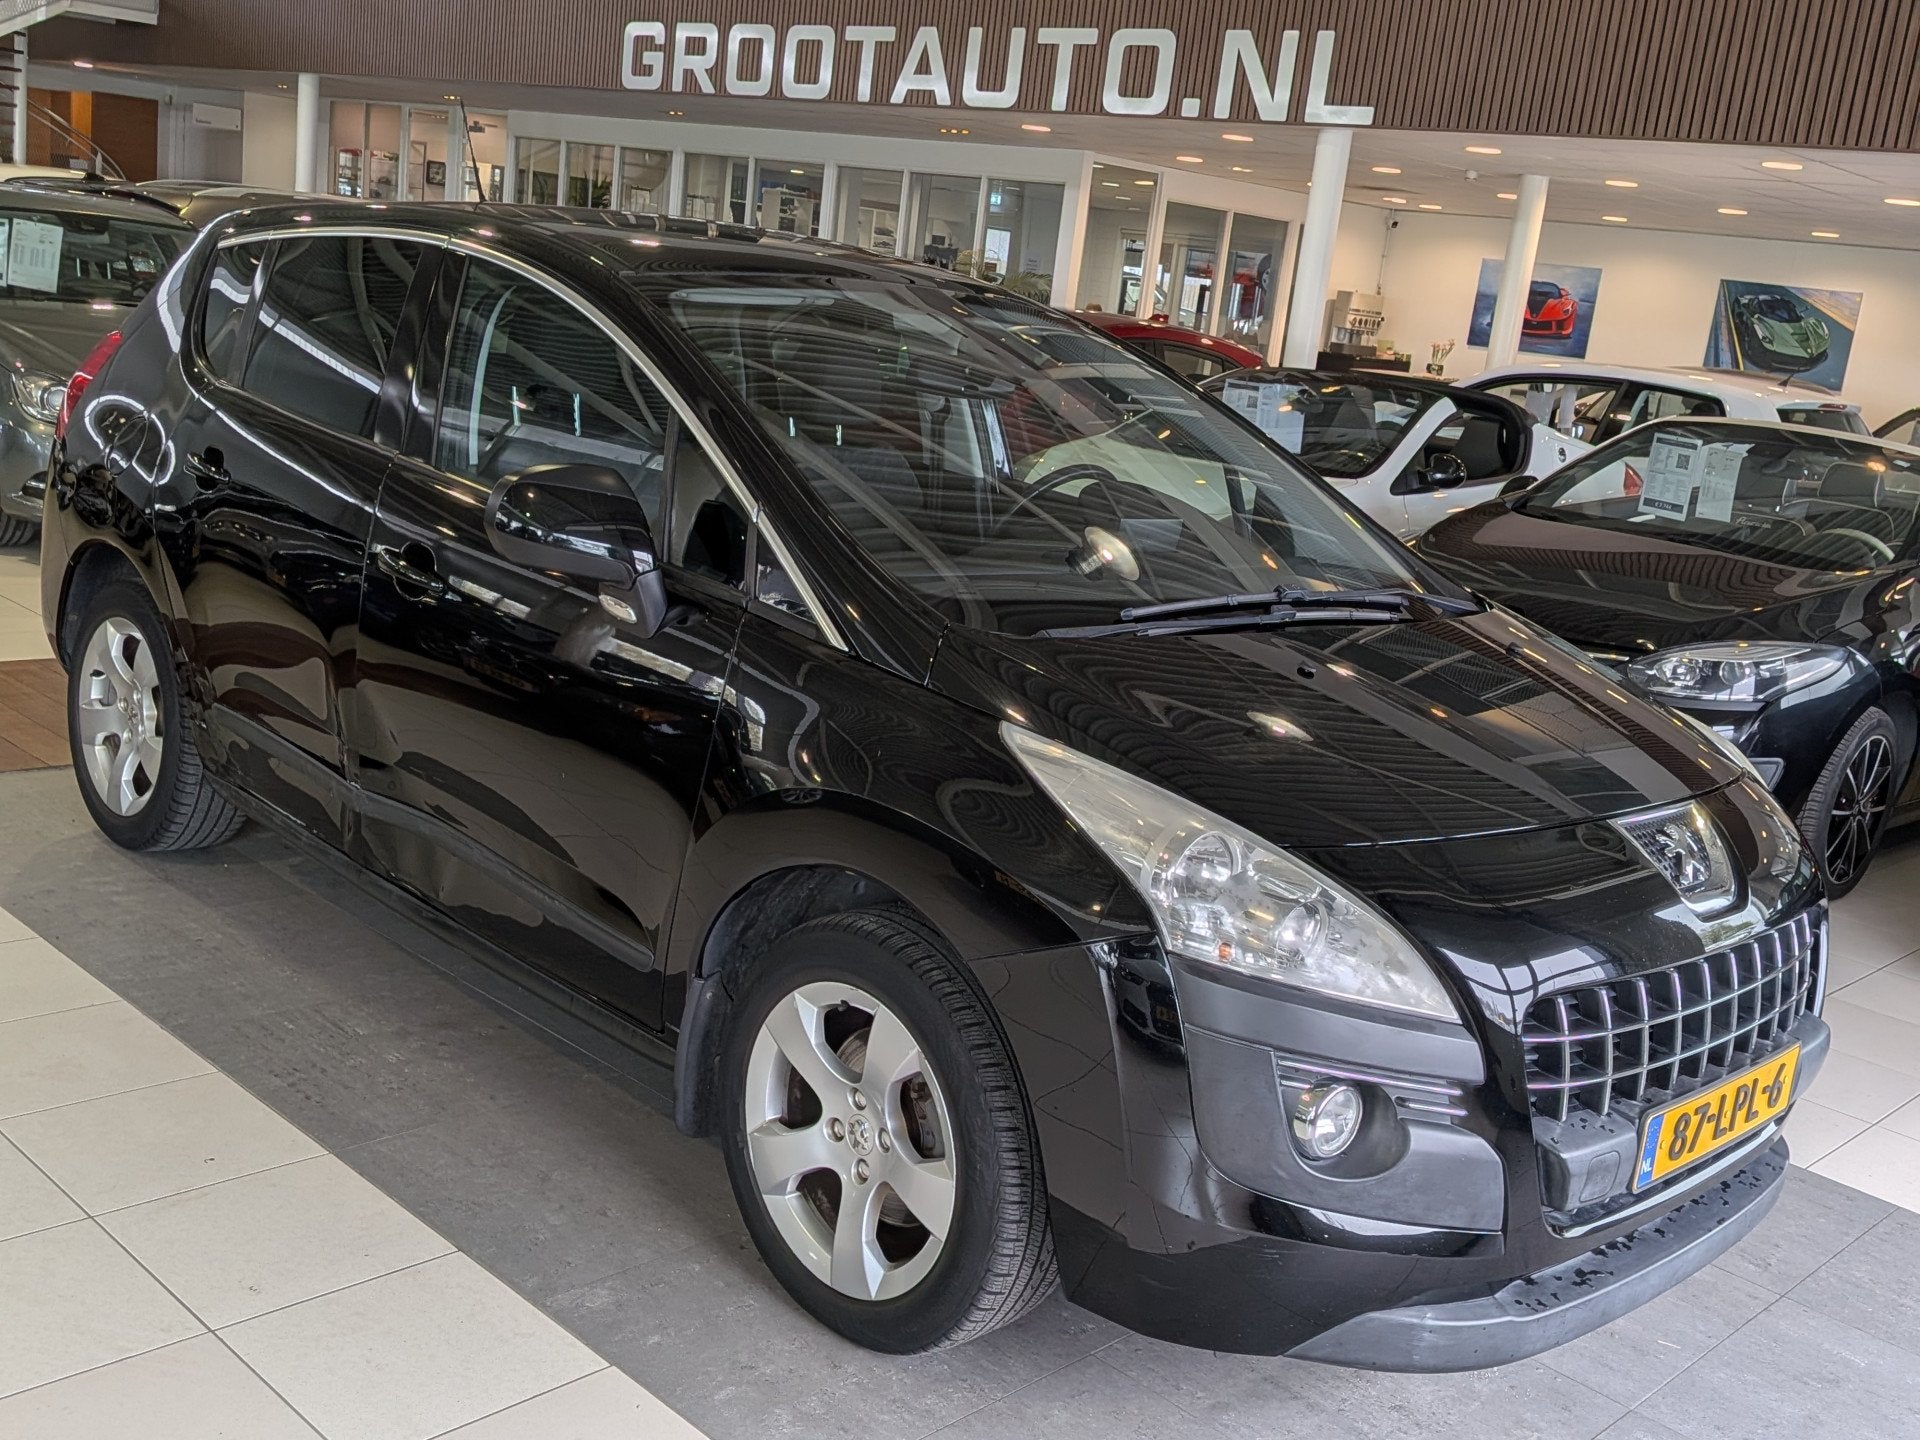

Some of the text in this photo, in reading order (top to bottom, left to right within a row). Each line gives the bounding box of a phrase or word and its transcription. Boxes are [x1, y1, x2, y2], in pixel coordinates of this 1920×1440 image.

[621, 21, 1374, 126] GROOTAUTO.NL
[1668, 1063, 1786, 1160] 87-LPL-6
[1641, 1157, 1652, 1175] NL
